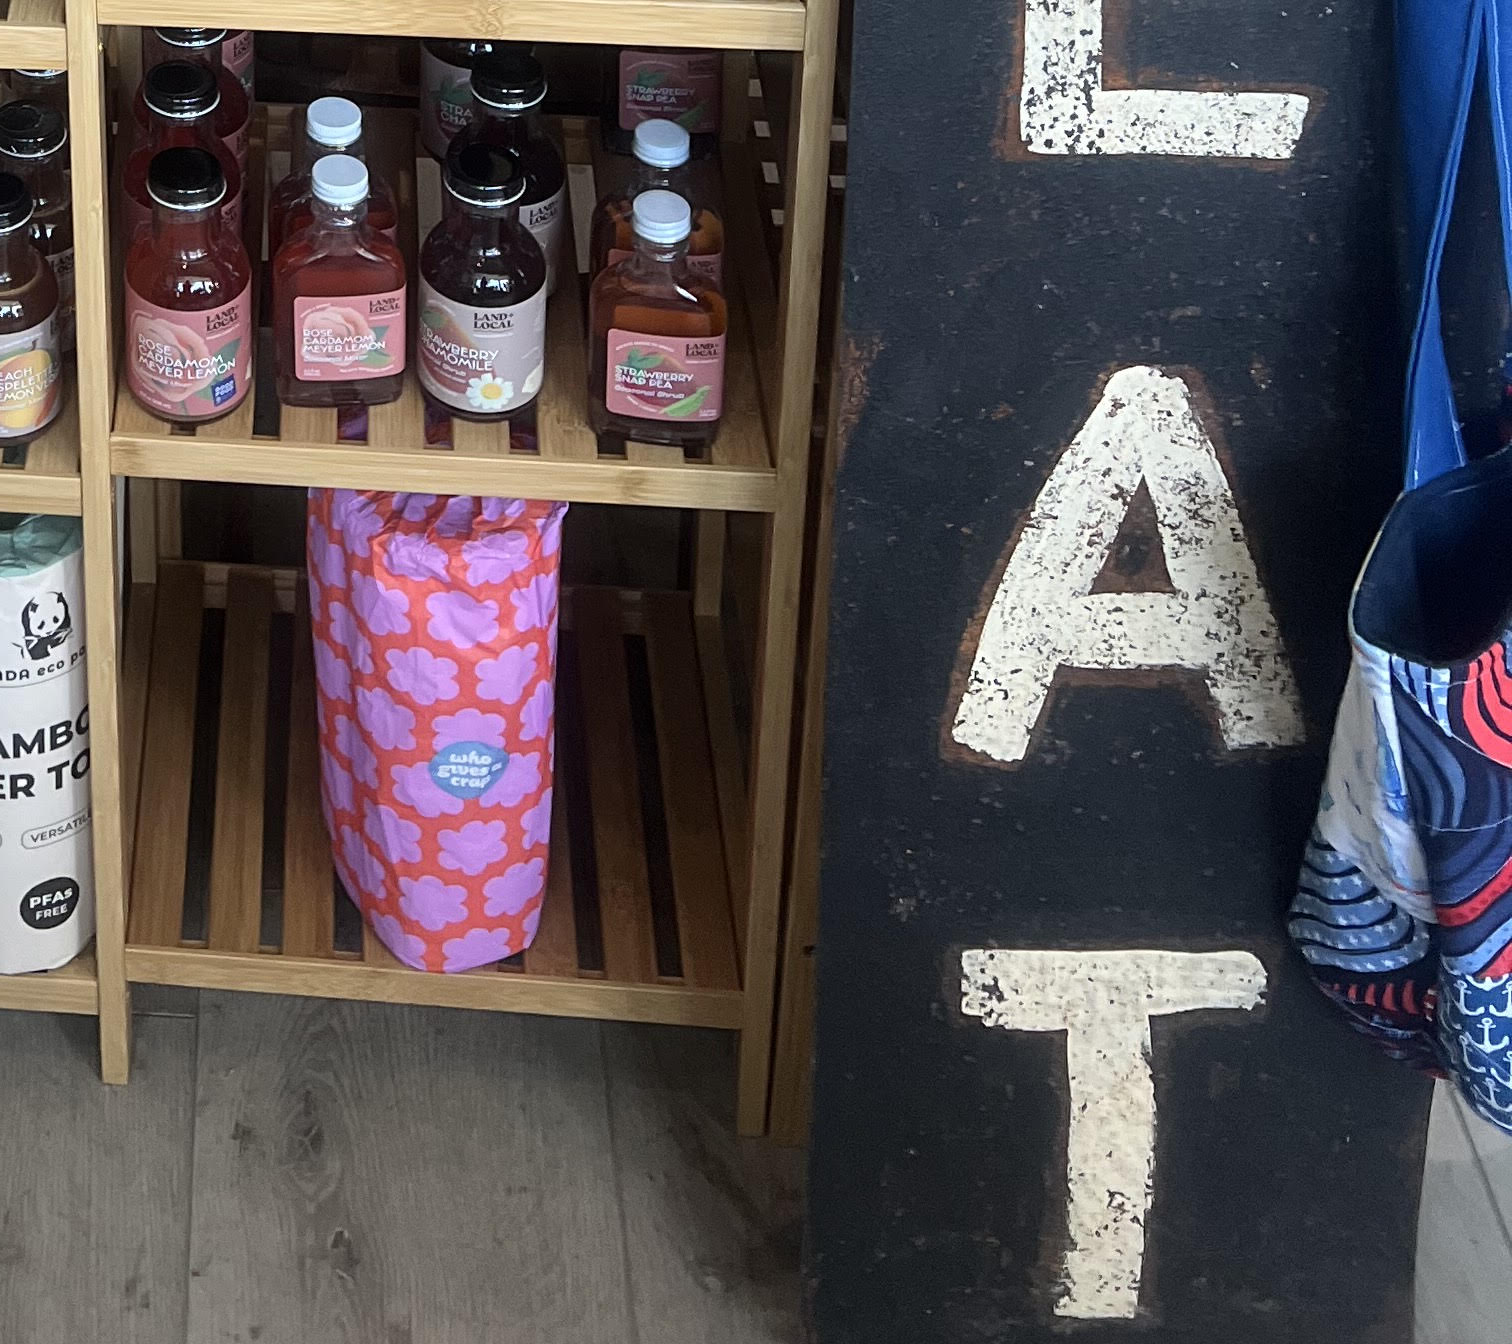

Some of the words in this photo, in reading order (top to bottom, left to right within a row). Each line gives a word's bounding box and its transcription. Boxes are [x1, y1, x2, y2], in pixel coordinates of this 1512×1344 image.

[138, 343, 224, 370] CARDAMOM
[449, 750, 493, 767] who
[437, 764, 490, 779] gives
[450, 773, 491, 789] crap
